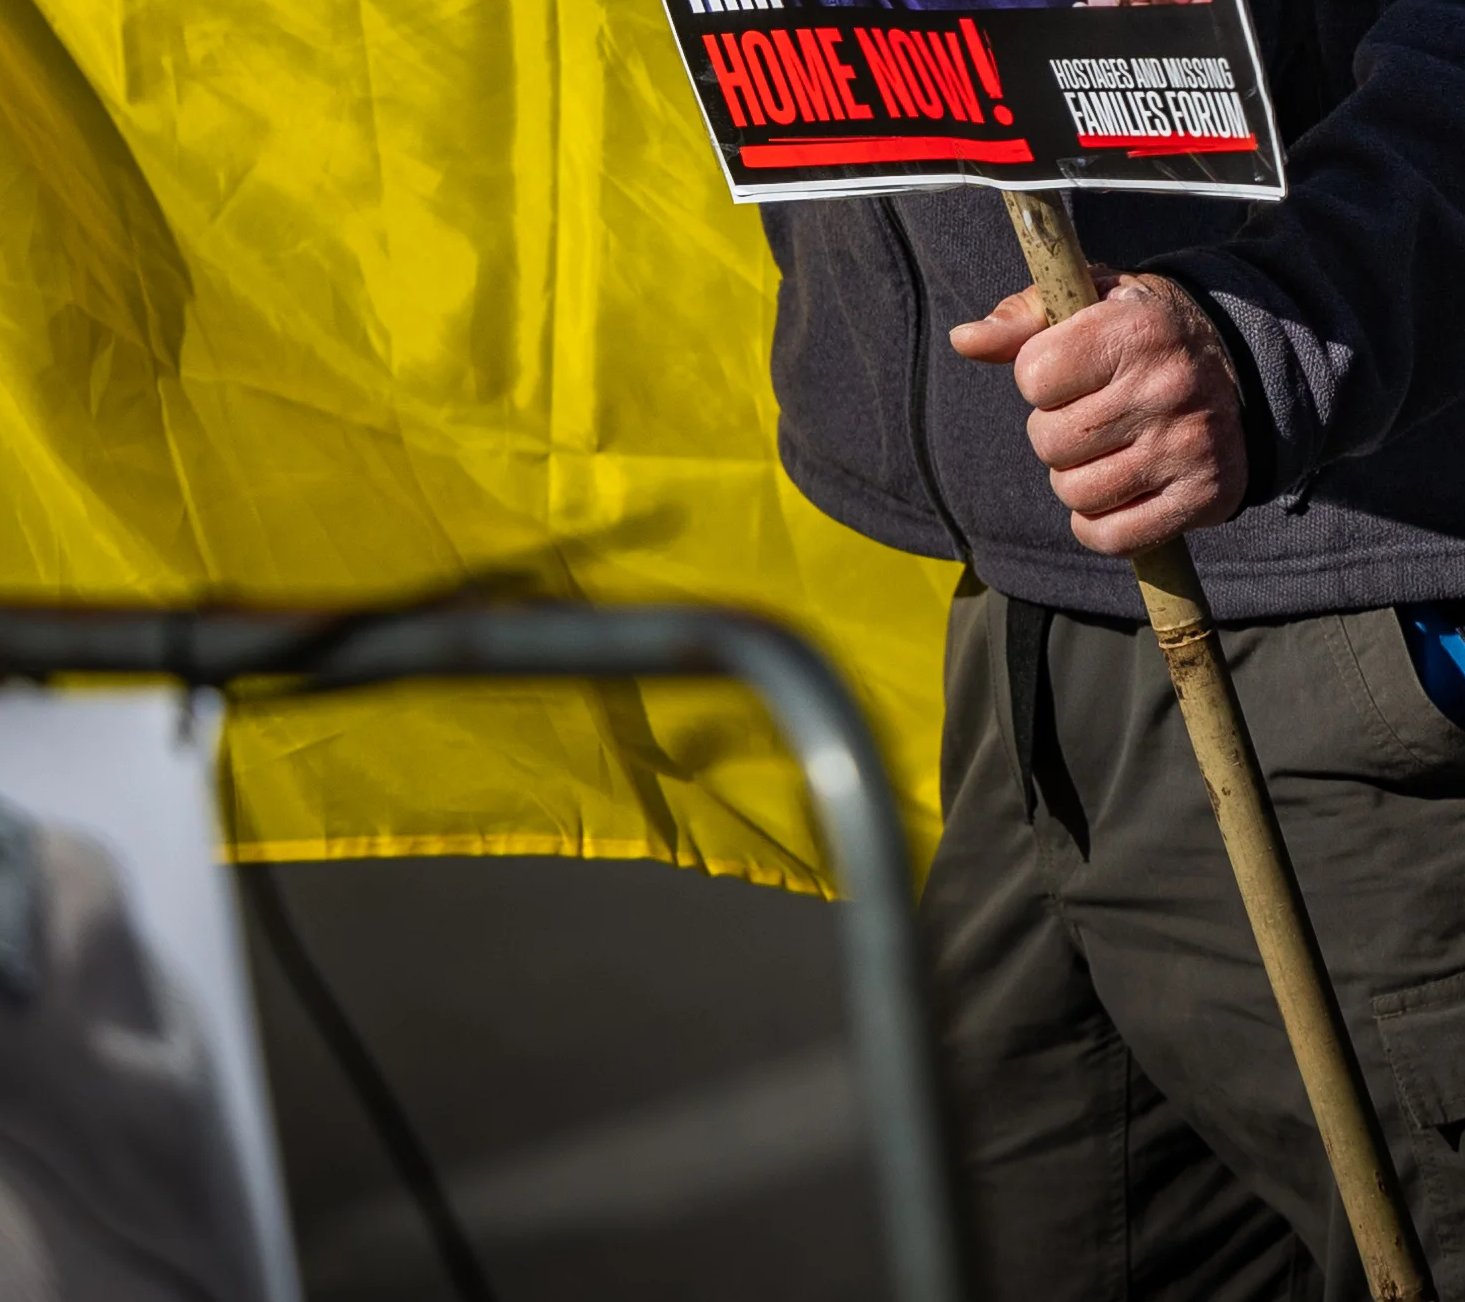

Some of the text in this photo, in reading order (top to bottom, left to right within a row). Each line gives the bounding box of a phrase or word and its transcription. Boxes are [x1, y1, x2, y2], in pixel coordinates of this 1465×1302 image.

[701, 17, 1015, 128] HOME NOW!
[1049, 57, 1236, 90] HOSTAGES AND MISSING
[1063, 92, 1252, 139] FAMILIES FORUM
